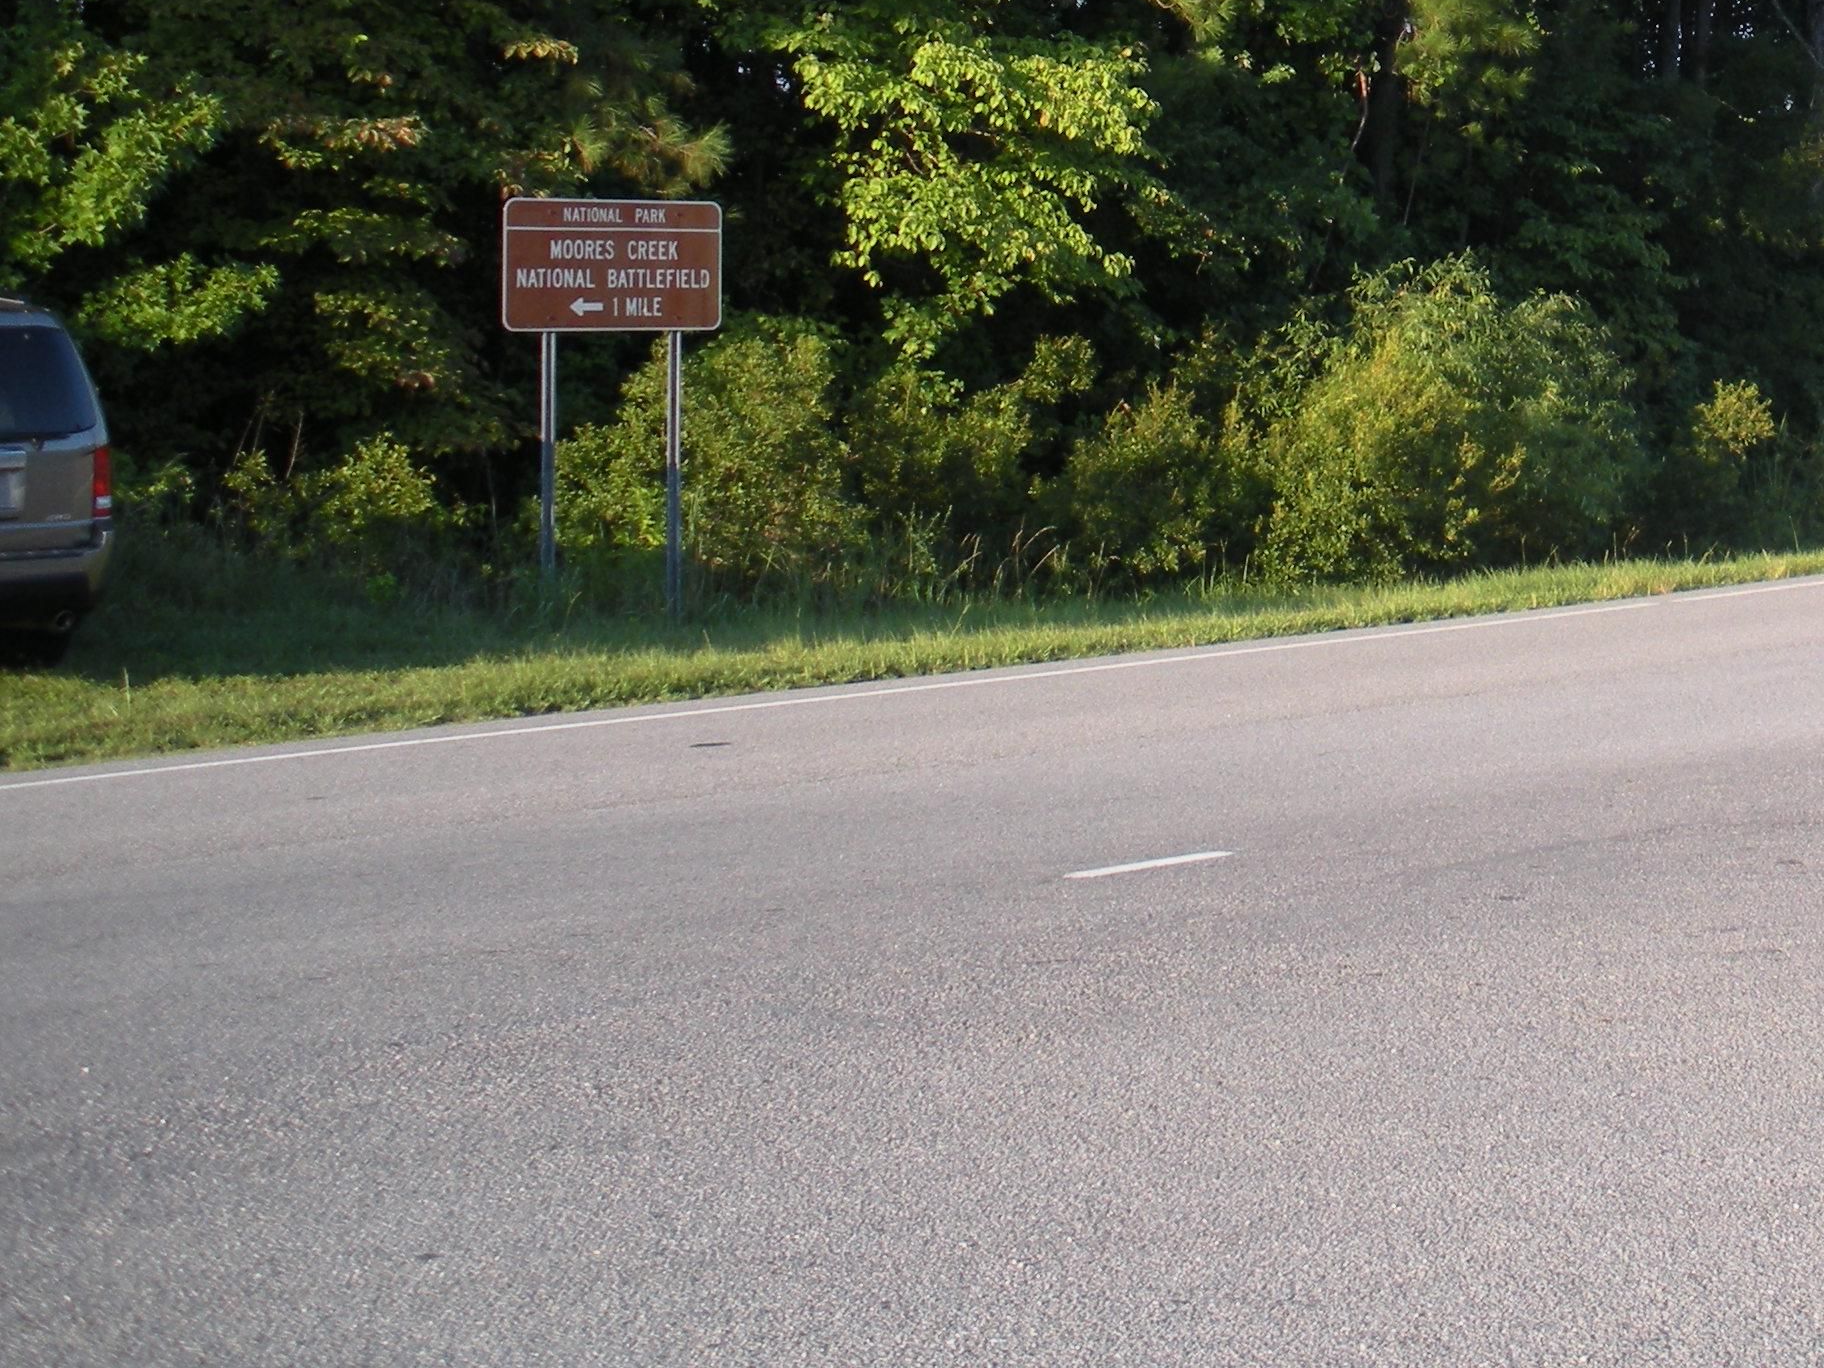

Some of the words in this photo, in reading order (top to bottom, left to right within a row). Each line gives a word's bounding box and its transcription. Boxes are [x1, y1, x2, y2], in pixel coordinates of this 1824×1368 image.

[563, 207, 623, 223] NATIONAL
[635, 208, 667, 224] PARK
[550, 239, 615, 260] MOORES
[627, 240, 679, 260] CREEK
[516, 268, 596, 289] NATIONAL
[607, 269, 710, 289] BATTLEFIELD
[612, 297, 619, 317] 1
[626, 297, 662, 317] MILE
